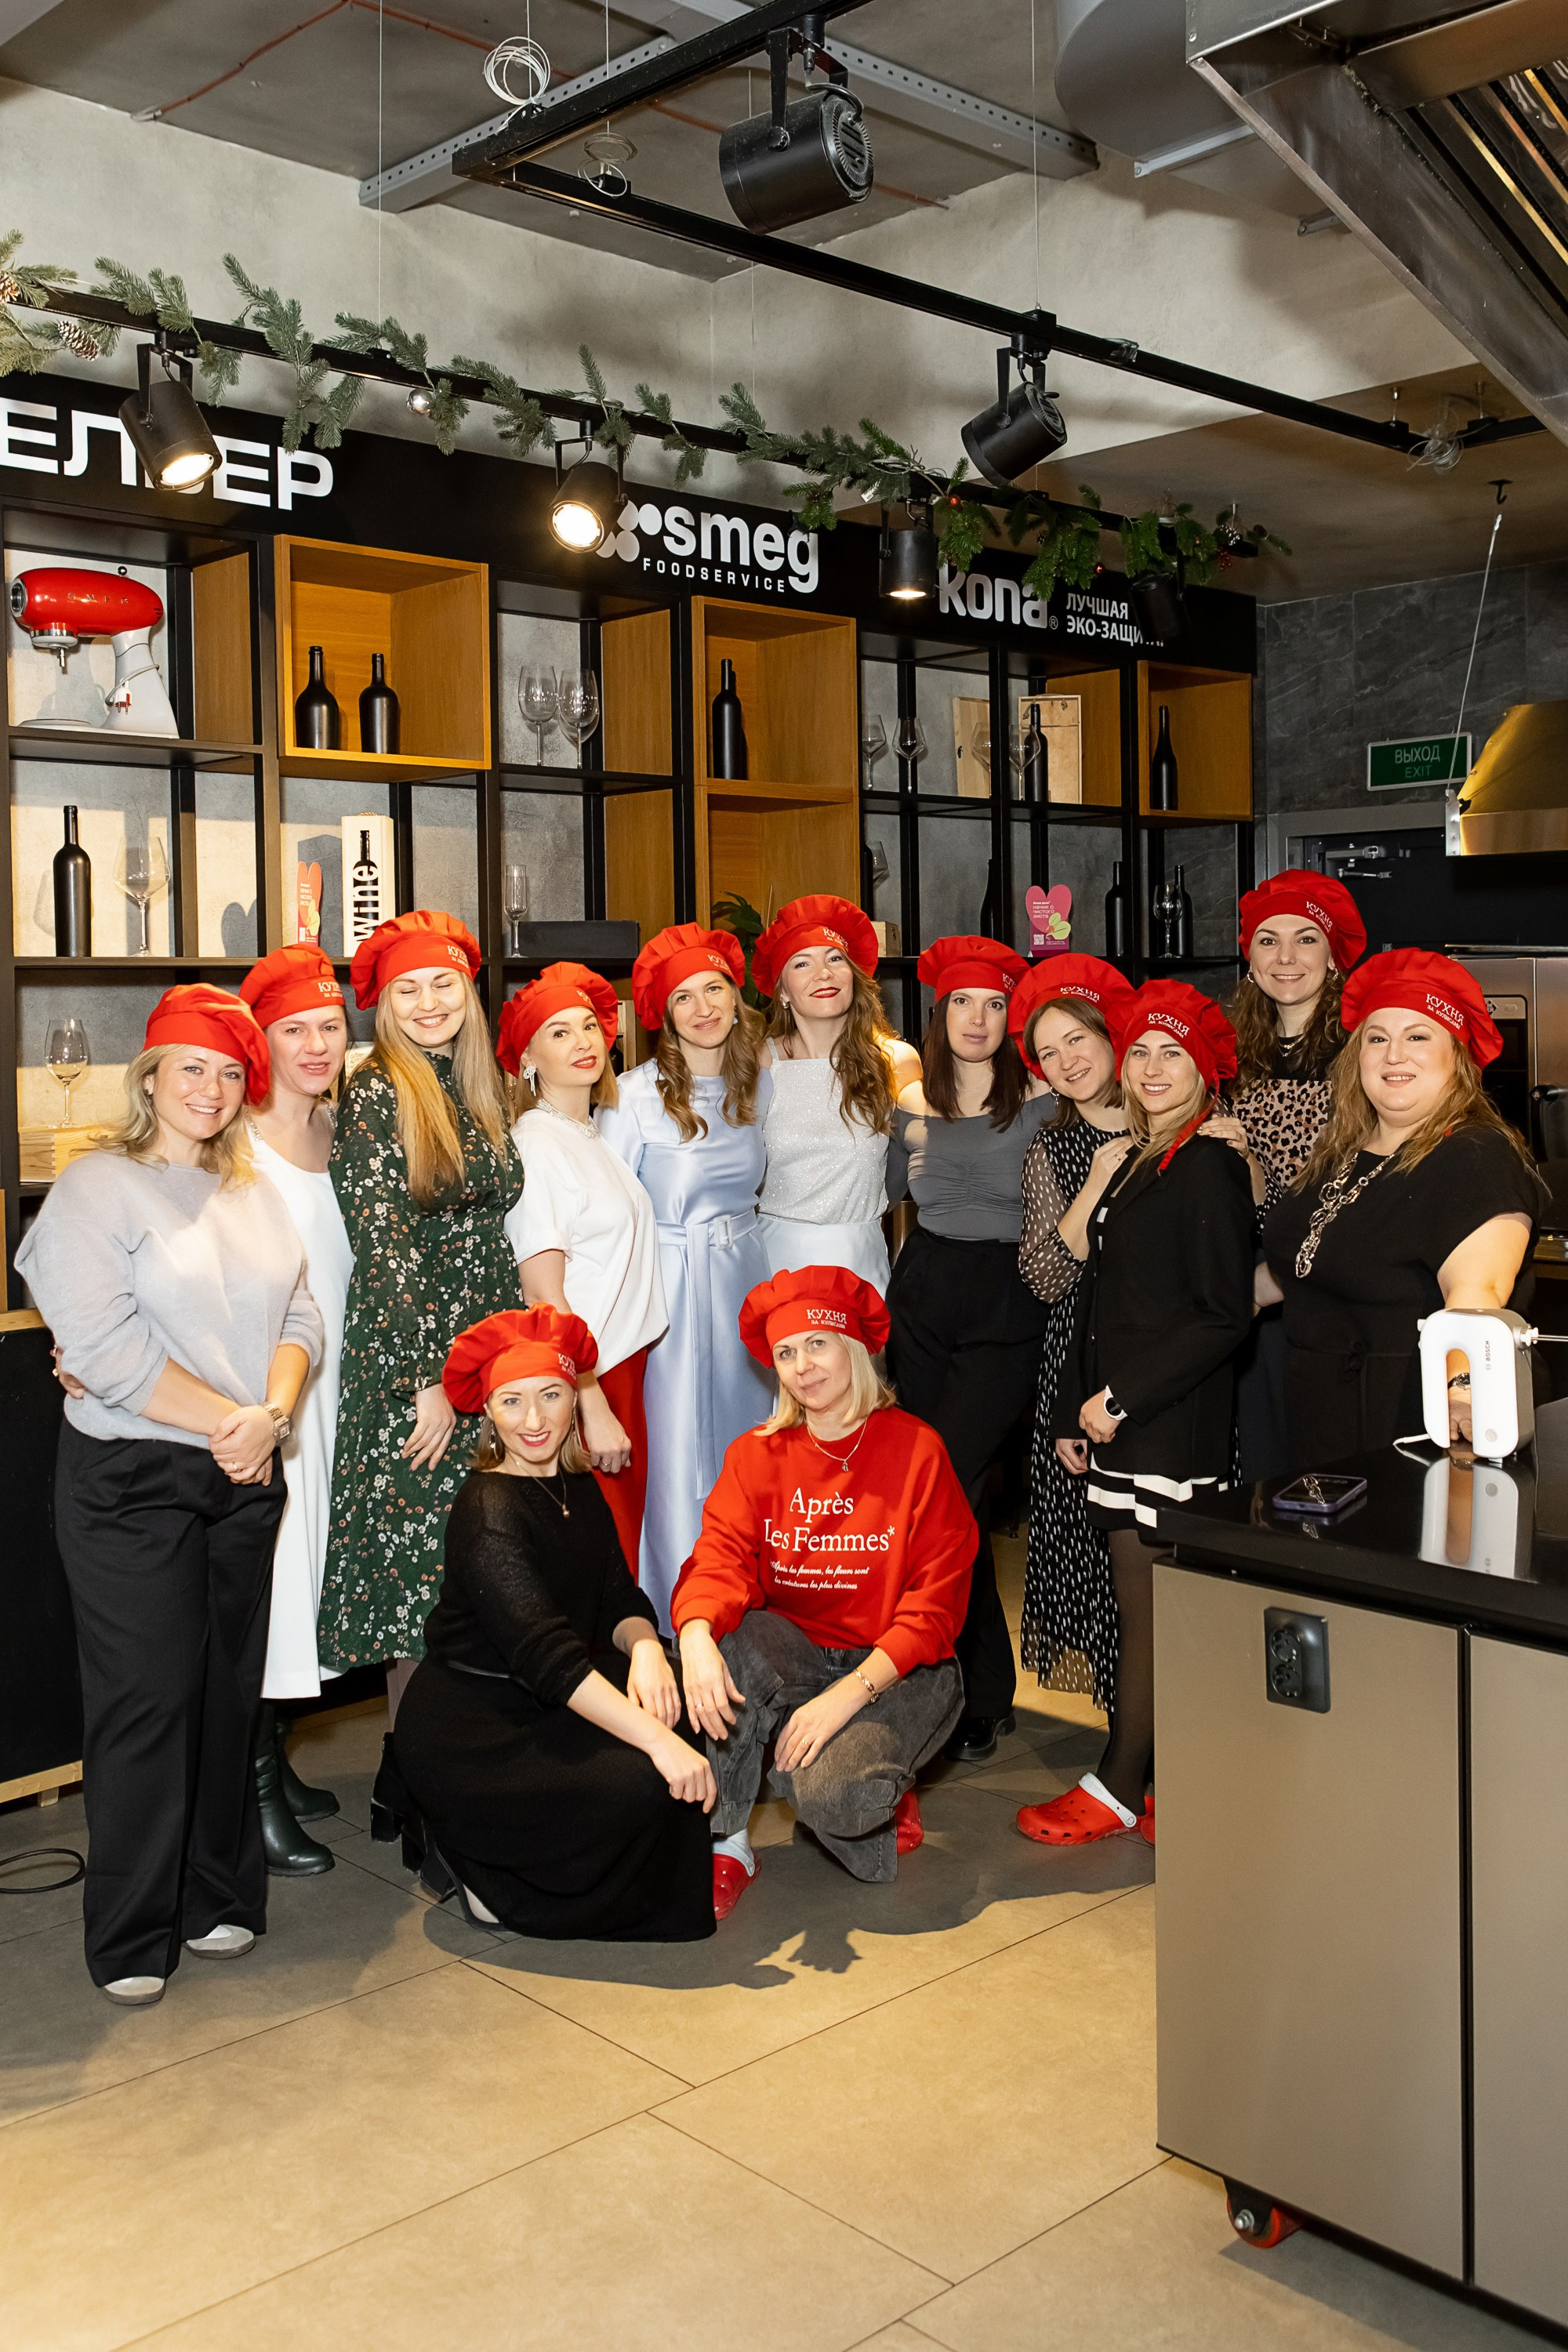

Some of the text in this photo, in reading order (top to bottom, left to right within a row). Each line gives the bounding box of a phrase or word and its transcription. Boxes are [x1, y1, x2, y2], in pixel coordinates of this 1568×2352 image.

[0, 397, 333, 511] ЕЛЕР
[663, 506, 818, 593] smeg
[643, 557, 785, 593] FOODSERVICE
[938, 560, 1047, 629] kona
[1066, 593, 1128, 619] ЛУЧШАЯ
[1395, 745, 1440, 764] ВЫХОД
[1405, 765, 1432, 779] EXIT
[1148, 1013, 1190, 1036] КУХНЯ
[1426, 993, 1465, 1026] КУХНЯ
[806, 1308, 848, 1324] КУХНЯ
[789, 1487, 854, 1523] Après
[764, 1519, 789, 1550] Les
